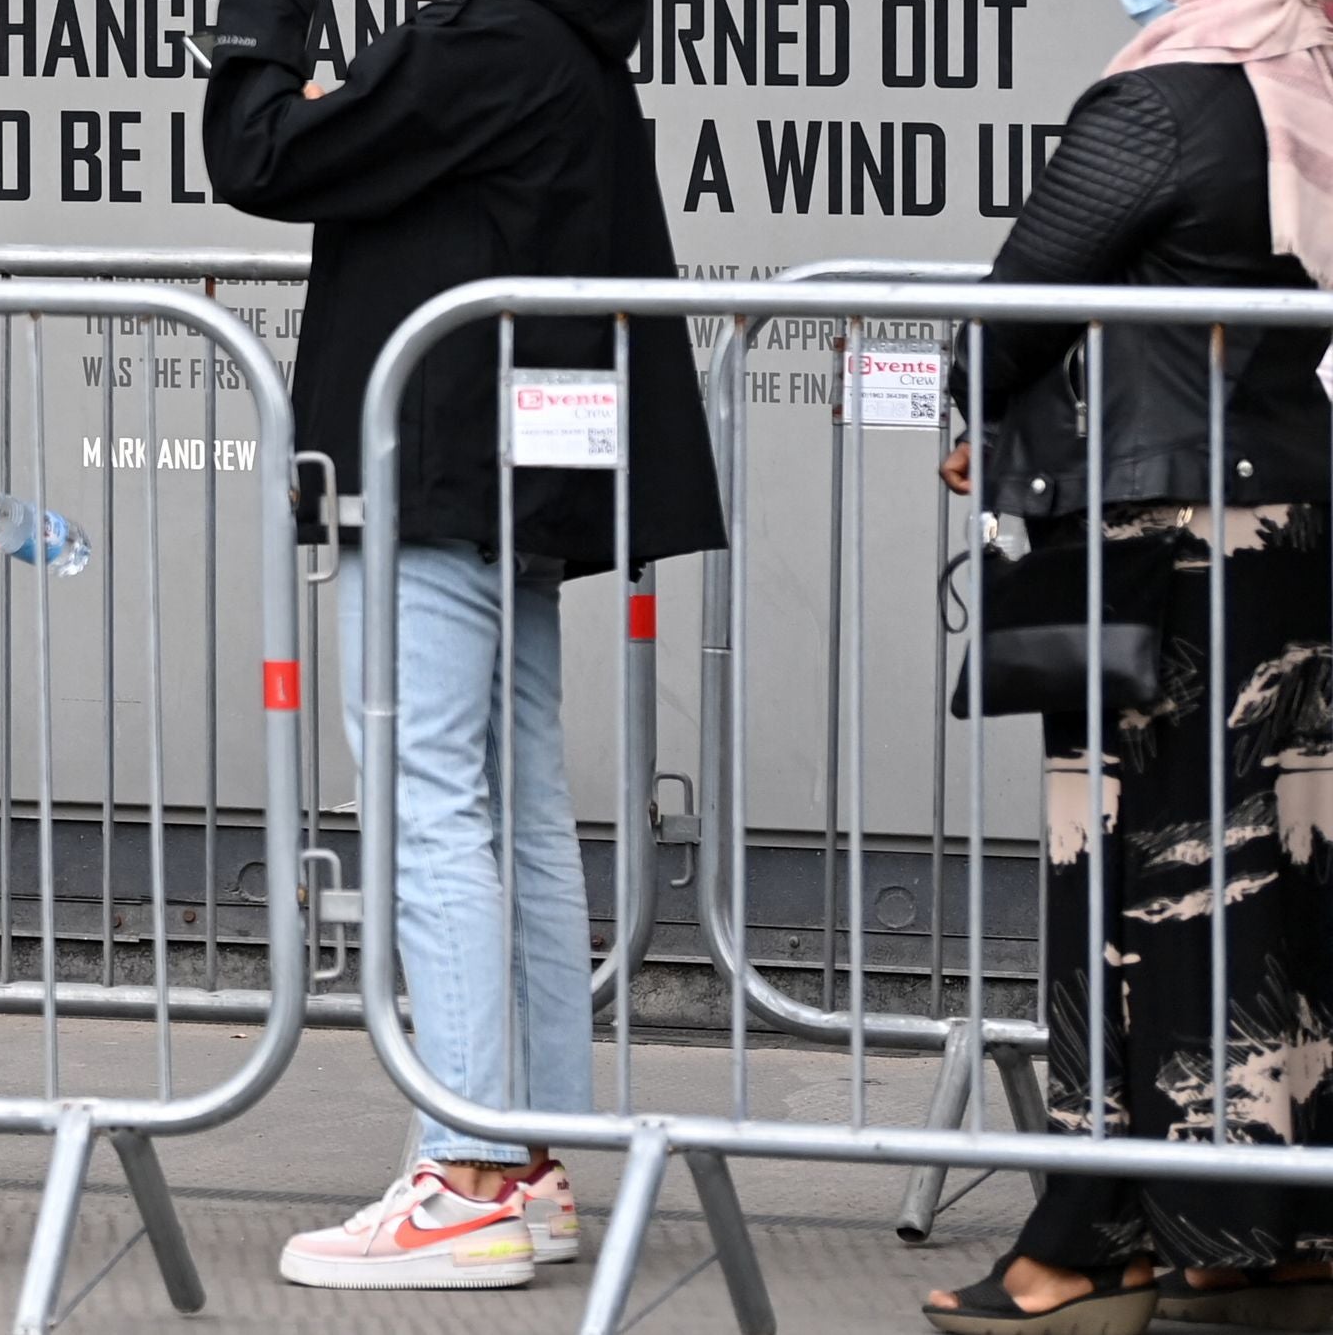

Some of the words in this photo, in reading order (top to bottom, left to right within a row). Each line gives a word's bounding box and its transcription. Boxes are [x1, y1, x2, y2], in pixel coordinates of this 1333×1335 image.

[61, 110, 142, 203] BE
[683, 119, 734, 212] A
[757, 120, 946, 216] WIND
[900, 374, 936, 386] Crew
